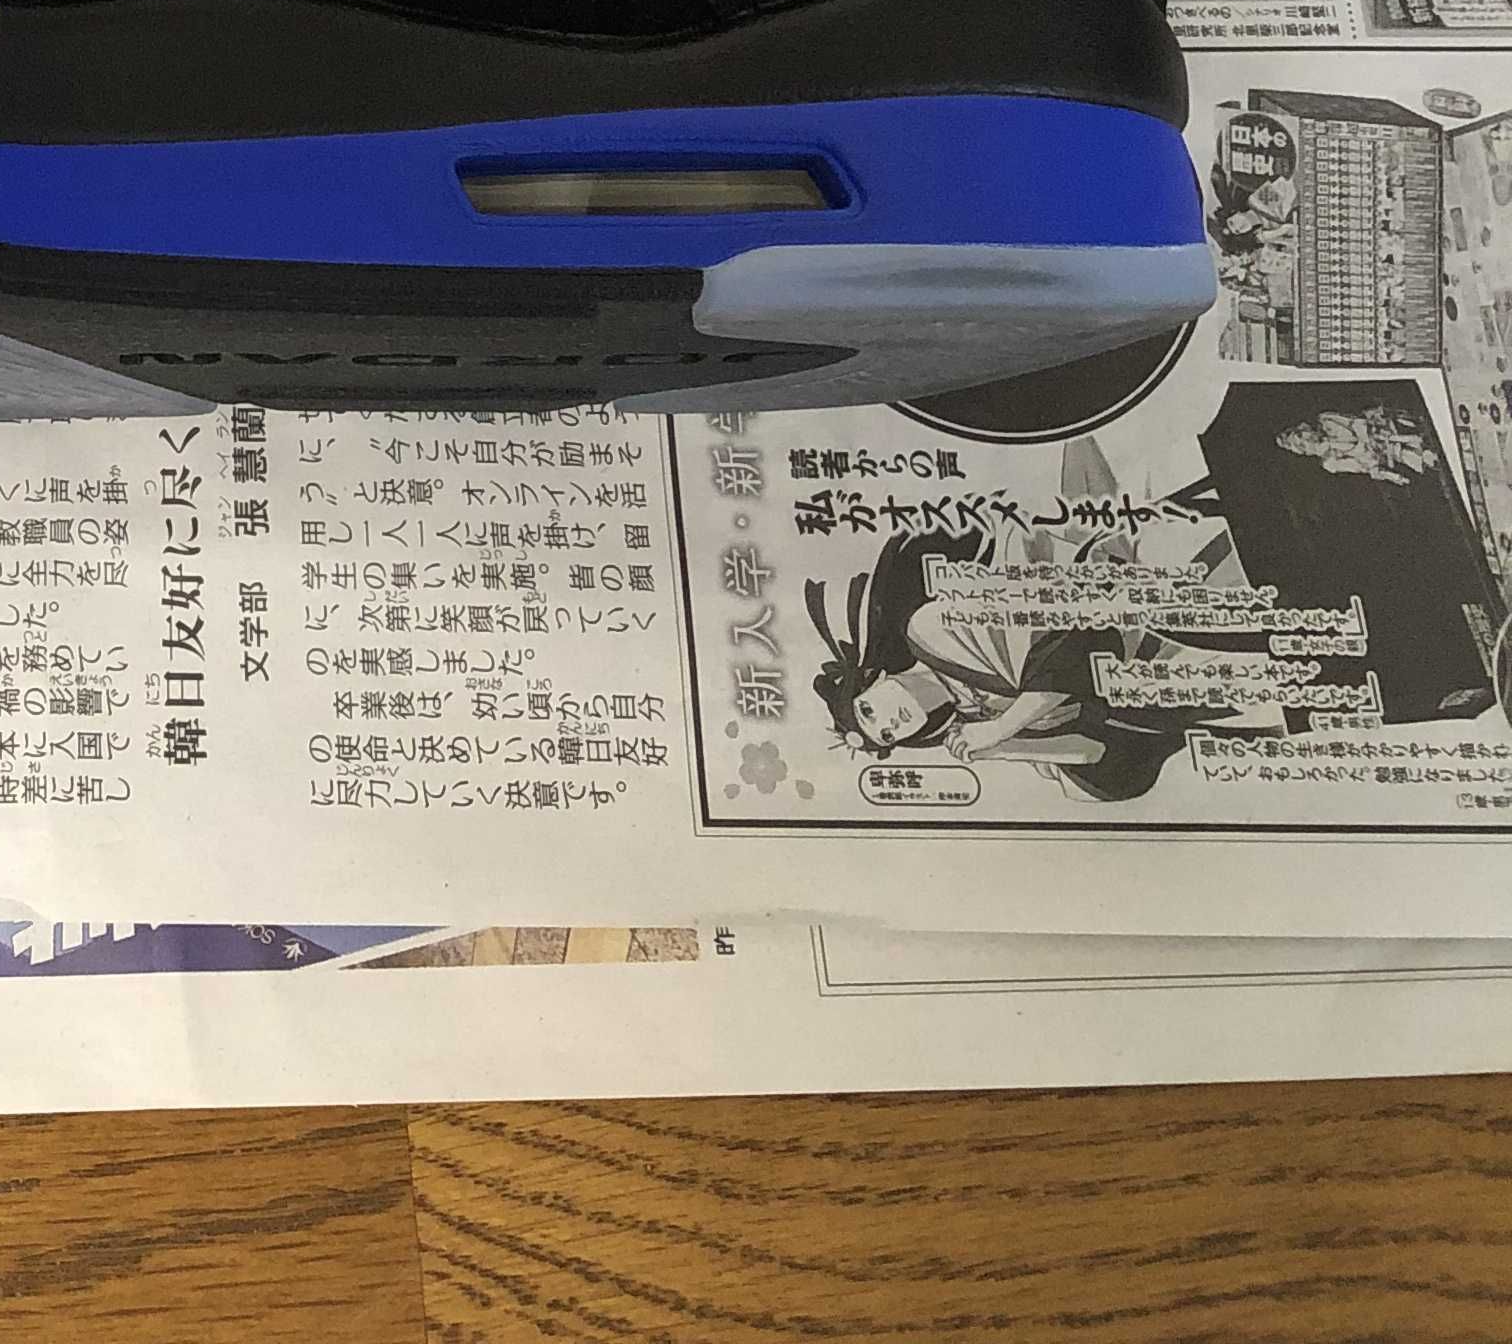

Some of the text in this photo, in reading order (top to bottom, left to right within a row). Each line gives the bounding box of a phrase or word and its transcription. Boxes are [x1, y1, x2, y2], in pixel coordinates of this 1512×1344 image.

[790, 448, 967, 480] 読者からの声
[234, 498, 269, 536] 張
[794, 489, 1200, 536] 私がオススメします！
[301, 519, 649, 550] 用し一人一人に声を掛け、留
[302, 562, 655, 592] 学生の集いを実施。皆の顔
[158, 424, 207, 766] 韓日友好に尽く
[238, 582, 269, 681] 文学部
[306, 604, 656, 633] に、次第に笑顔が戻っていく
[308, 648, 538, 676] のを実感しました。
[333, 690, 666, 722] 卒業後は、幼い頃から自分
[309, 735, 669, 766] の使命と決めている韓日友好
[310, 779, 629, 810] に尽力していく決意です。
